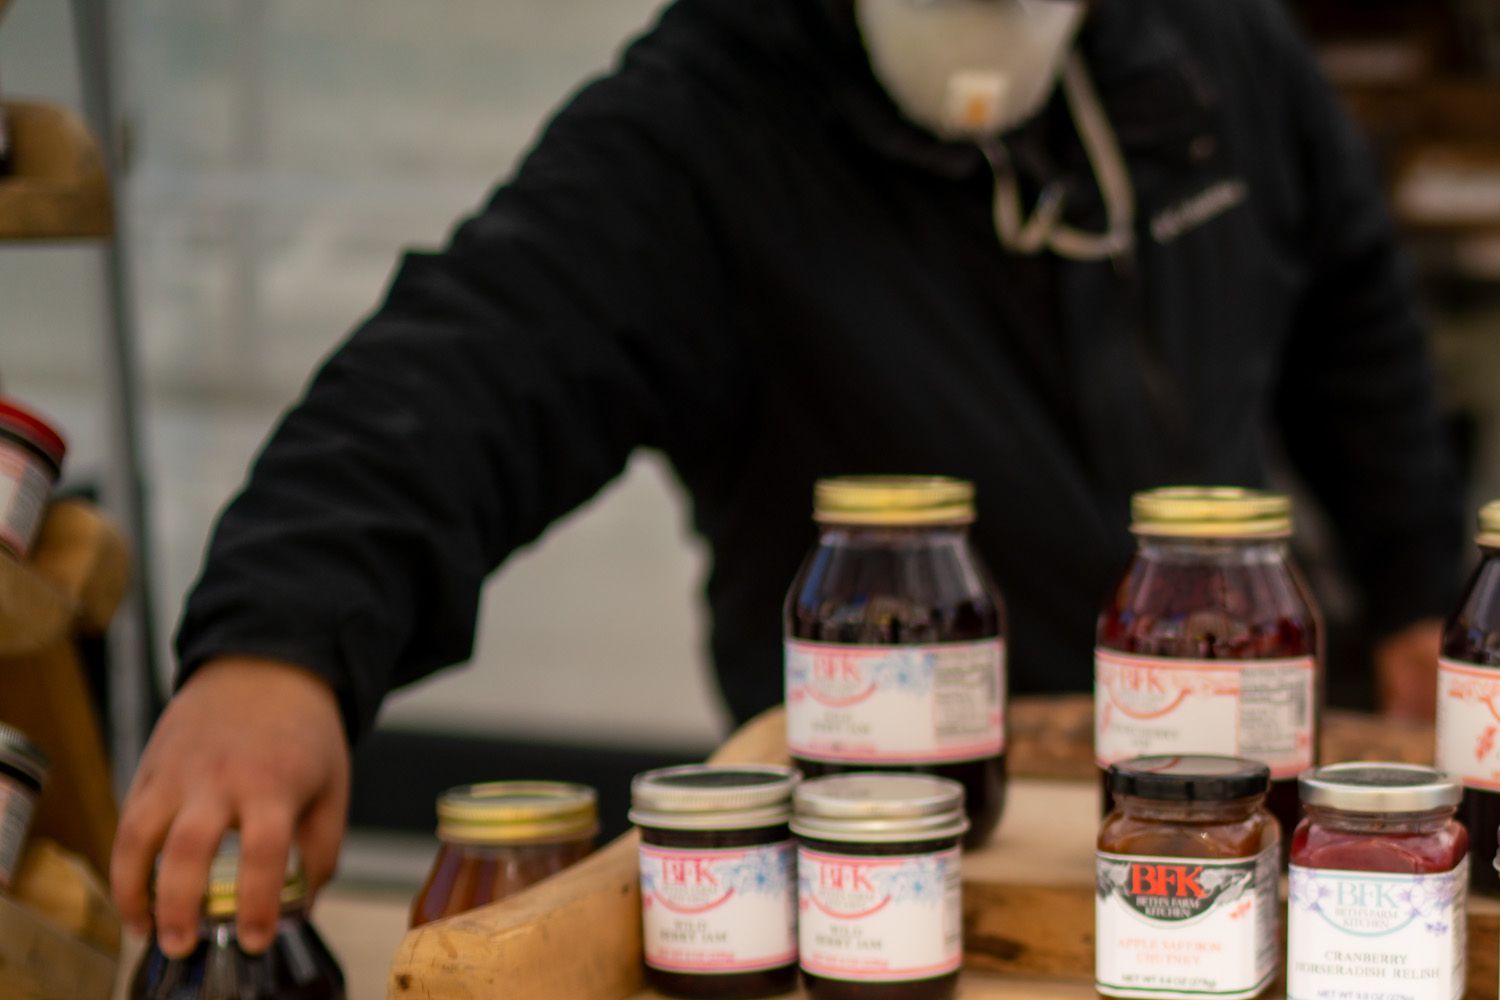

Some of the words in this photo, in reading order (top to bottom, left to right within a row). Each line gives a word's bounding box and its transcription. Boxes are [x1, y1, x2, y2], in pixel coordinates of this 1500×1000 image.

[1131, 863, 1208, 900] BFK
[1337, 881, 1400, 908] BFK
[1324, 950, 1408, 965] CRANBERRY
[1393, 967, 1440, 980] RELISH
